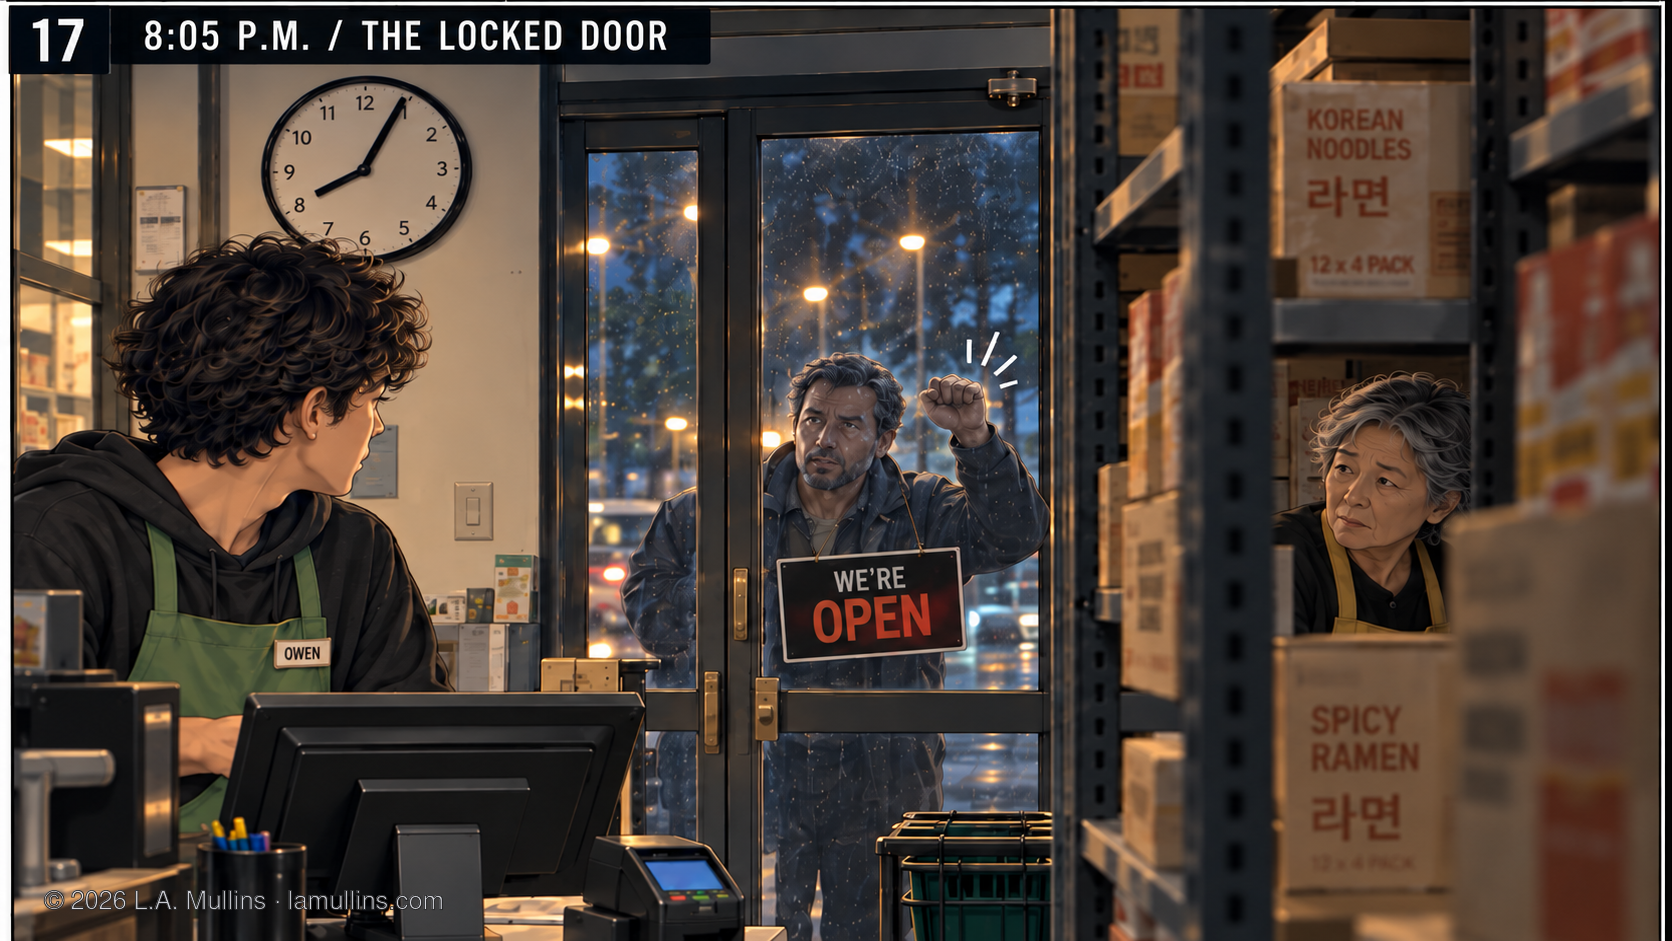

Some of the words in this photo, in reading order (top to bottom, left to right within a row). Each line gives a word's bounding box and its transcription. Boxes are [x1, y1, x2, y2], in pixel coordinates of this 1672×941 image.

[355, 95, 375, 111] 12
[320, 105, 335, 121] 11
[1307, 108, 1404, 131] KOREAN
[292, 130, 312, 145] 10
[425, 127, 438, 142] 2
[1307, 138, 1412, 160] NOODLES
[284, 164, 295, 180] 9
[436, 161, 448, 176] 3
[425, 195, 437, 210] 4
[1307, 175, 1389, 218] 라면
[294, 198, 306, 213] 8
[322, 221, 335, 236] 7
[399, 220, 410, 235] 5
[359, 231, 371, 246] 6
[1311, 255, 1332, 274] 12
[1336, 260, 1348, 274] x
[1351, 255, 1364, 274] 4
[1367, 255, 1416, 275] PACK
[833, 566, 907, 593] WE’RE
[812, 592, 932, 644] OPEN
[284, 646, 321, 661] OWEN
[1310, 704, 1402, 736] SPICY
[1311, 742, 1420, 772] RAMEN
[1311, 793, 1401, 842] 라면
